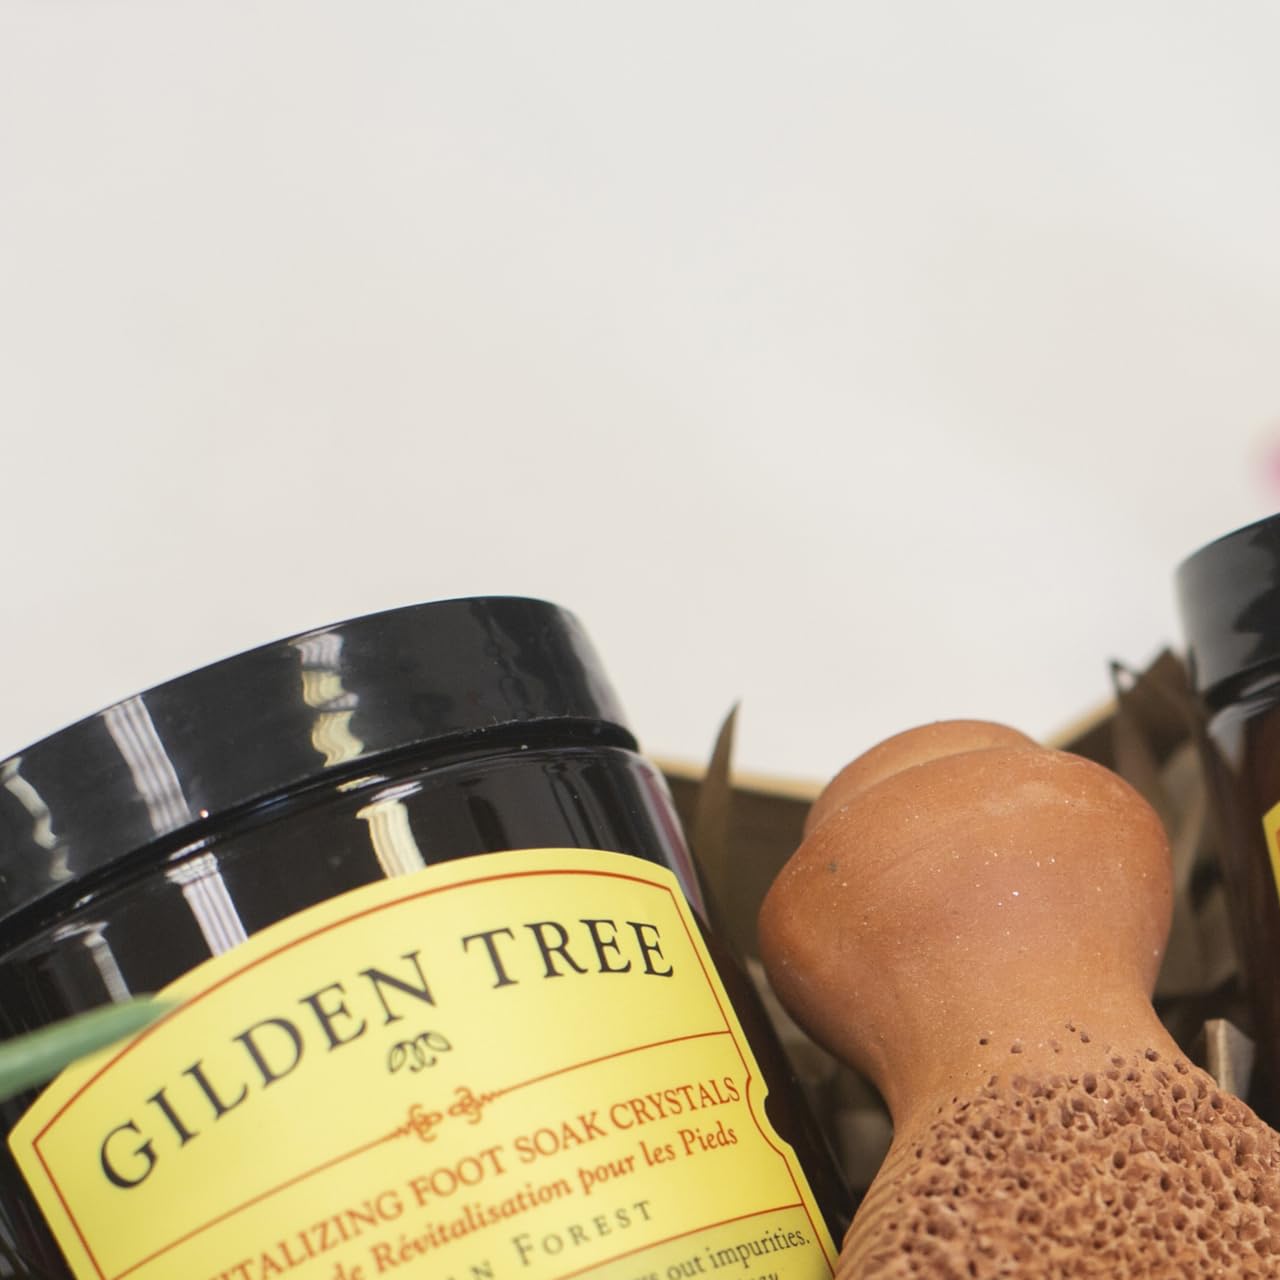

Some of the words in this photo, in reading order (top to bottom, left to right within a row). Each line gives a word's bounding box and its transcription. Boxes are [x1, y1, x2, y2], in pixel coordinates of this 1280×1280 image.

[99, 950, 439, 1191] GILDEN
[462, 917, 675, 991] TREE
[371, 1175, 574, 1274] Révitalisation
[578, 1154, 637, 1196] pour
[640, 1138, 676, 1170] les
[680, 1120, 738, 1157] Pieds
[407, 1147, 507, 1209] FOOT
[514, 1111, 608, 1165] SOAK
[608, 1076, 741, 1131] CRYSTALS
[705, 1229, 811, 1272] impurities.
